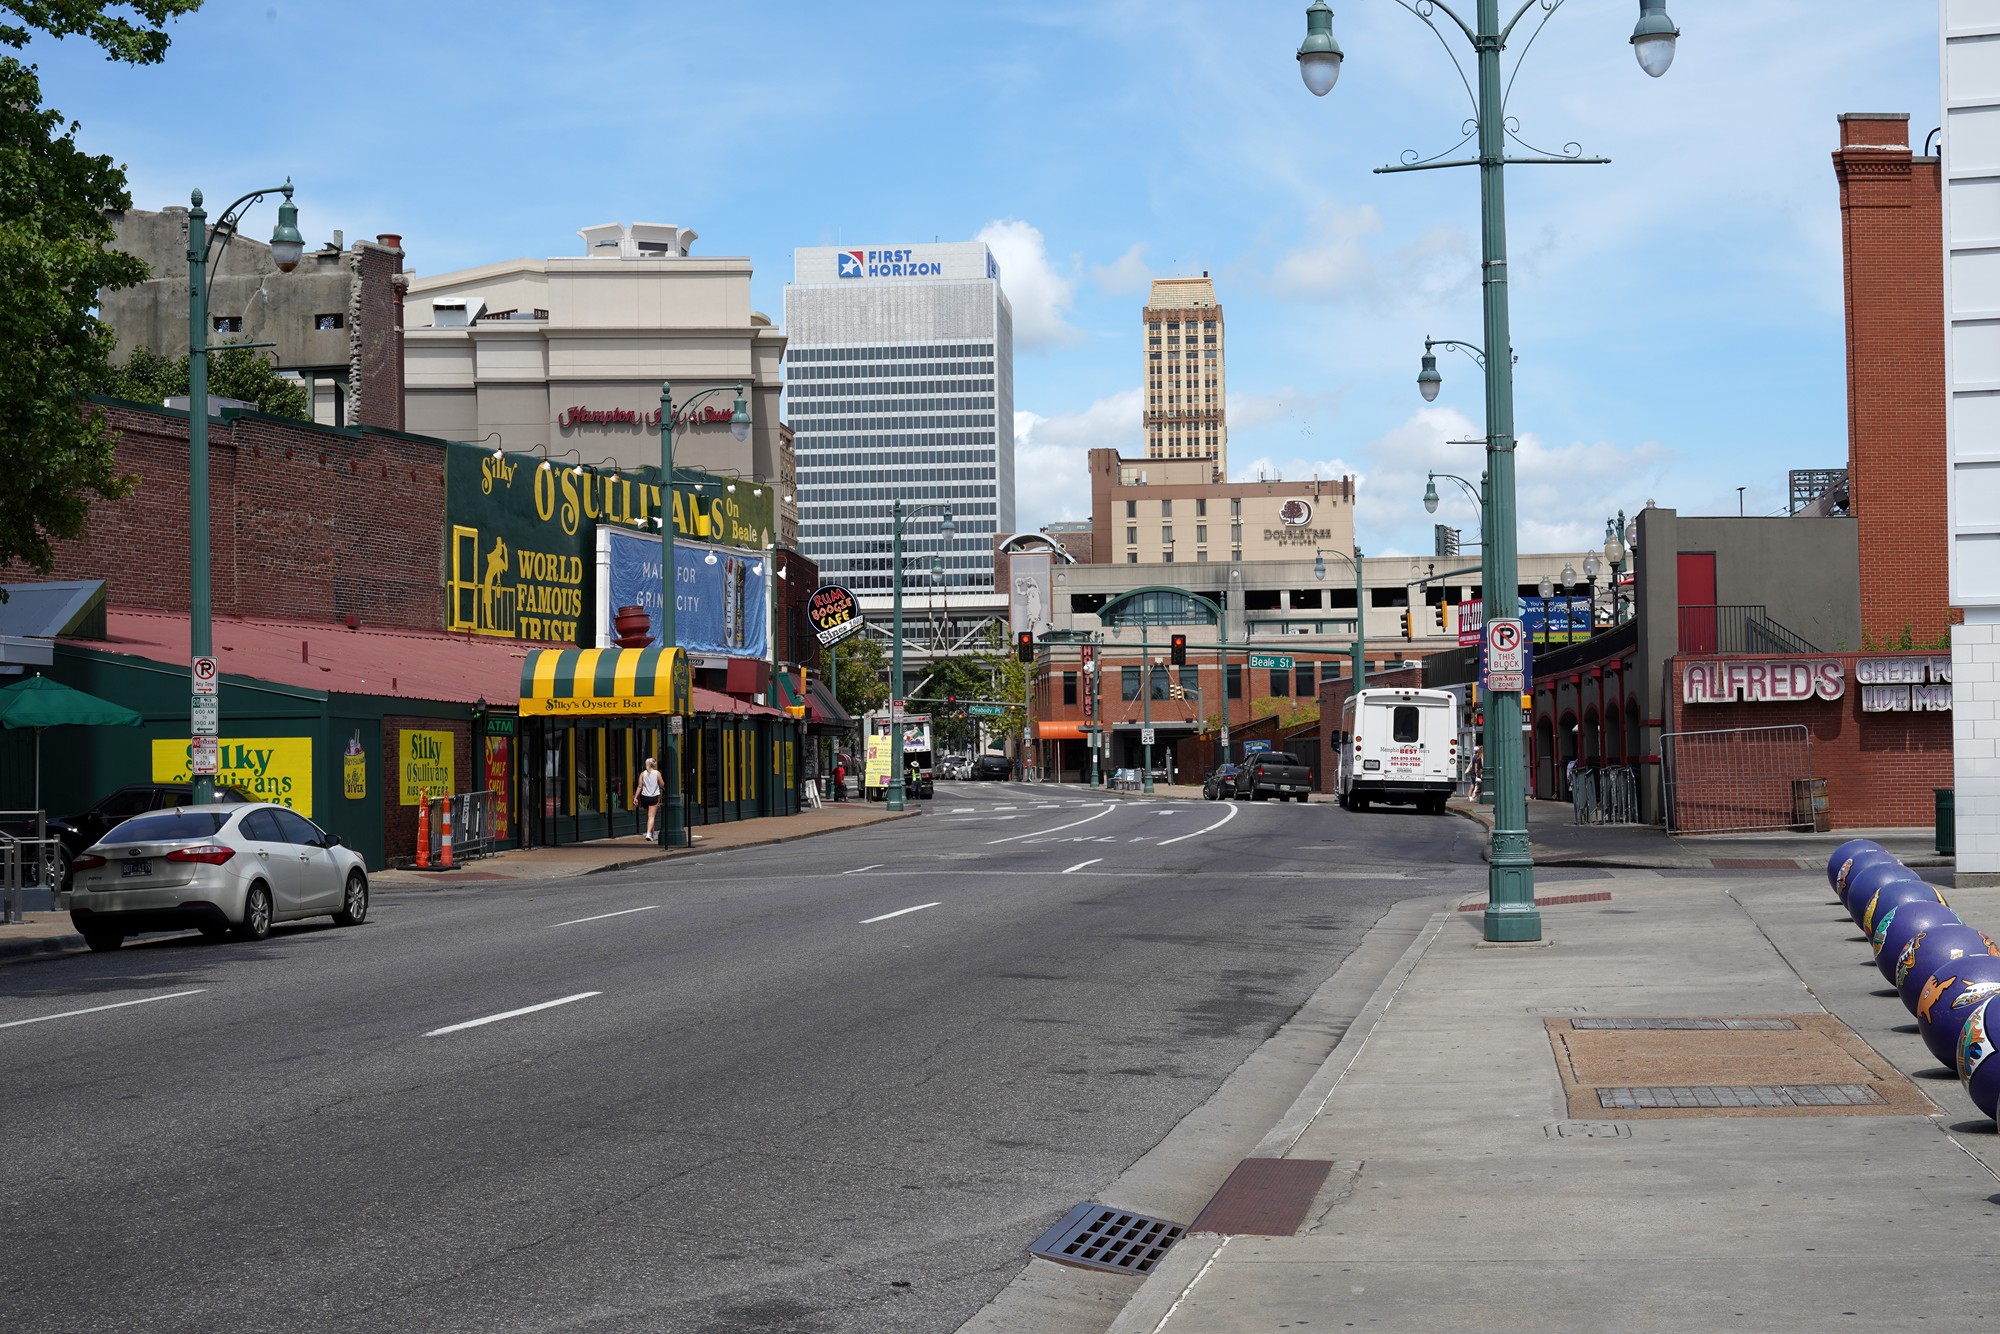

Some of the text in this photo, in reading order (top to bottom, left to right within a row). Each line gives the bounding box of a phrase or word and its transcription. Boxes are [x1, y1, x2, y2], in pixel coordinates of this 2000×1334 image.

[868, 250, 912, 262] FIRST
[868, 263, 941, 277] HORIZON
[558, 406, 642, 427] Hampton
[481, 456, 518, 495] Silky
[726, 497, 739, 518] On
[732, 523, 757, 543] Beale
[517, 549, 583, 585] WORLD
[677, 566, 697, 584] FOR
[516, 584, 582, 618] FAMOUS
[676, 595, 700, 612] CITY
[813, 588, 846, 608] RUM
[811, 597, 852, 620] BOOGIE
[519, 616, 578, 642] IRISH
[820, 609, 850, 629] CAFE
[1251, 656, 1275, 668] Beale
[1493, 661, 1520, 669] BLOCK
[1498, 653, 1516, 661] THIS
[1083, 646, 1092, 715] HOTERS
[1688, 662, 1841, 699] ALFRED'S
[1859, 659, 1926, 681] GREAT
[545, 699, 643, 711] Silky's Oyster Bar
[1865, 688, 1905, 709] LIVE
[487, 720, 512, 732] ATM
[411, 734, 442, 767] Silky
[406, 762, 449, 784] O'Sullivans
